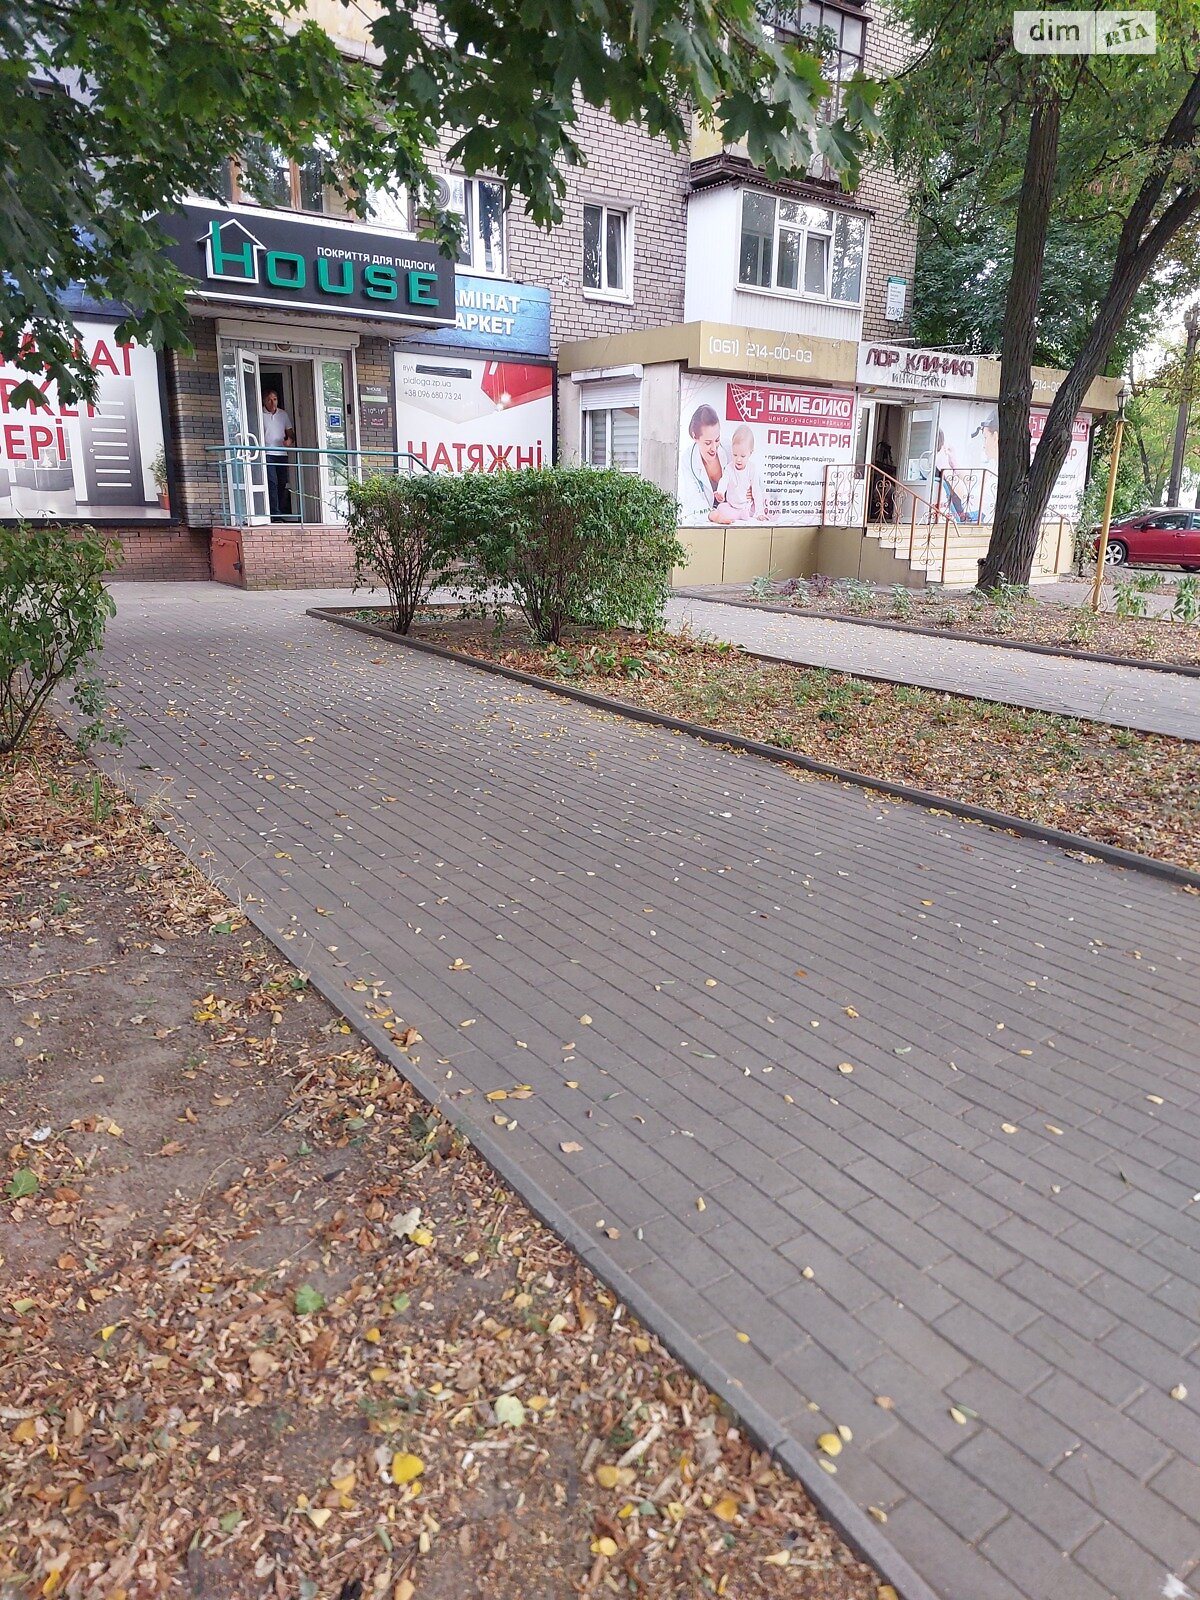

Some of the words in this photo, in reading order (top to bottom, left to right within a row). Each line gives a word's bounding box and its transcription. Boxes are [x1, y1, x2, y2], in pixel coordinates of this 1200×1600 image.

[211, 220, 440, 306] HOUSE
[317, 246, 370, 263] ПОКРИТТЯ
[372, 254, 393, 265] ДЛЯ
[395, 258, 436, 272] ПІДЛОГИ
[709, 336, 739, 357] (061)
[746, 342, 813, 363] 214-00-03
[866, 347, 900, 368] ЛОР
[405, 389, 416, 397] +38
[418, 389, 430, 398] 096
[454, 392, 462, 400] 24
[768, 394, 851, 418] ІНМЕДИКО
[768, 415, 788, 423] центр
[767, 429, 851, 448] ПЕДІАТРІЯ
[768, 454, 790, 462] прийом
[767, 479, 783, 487] виїзд
